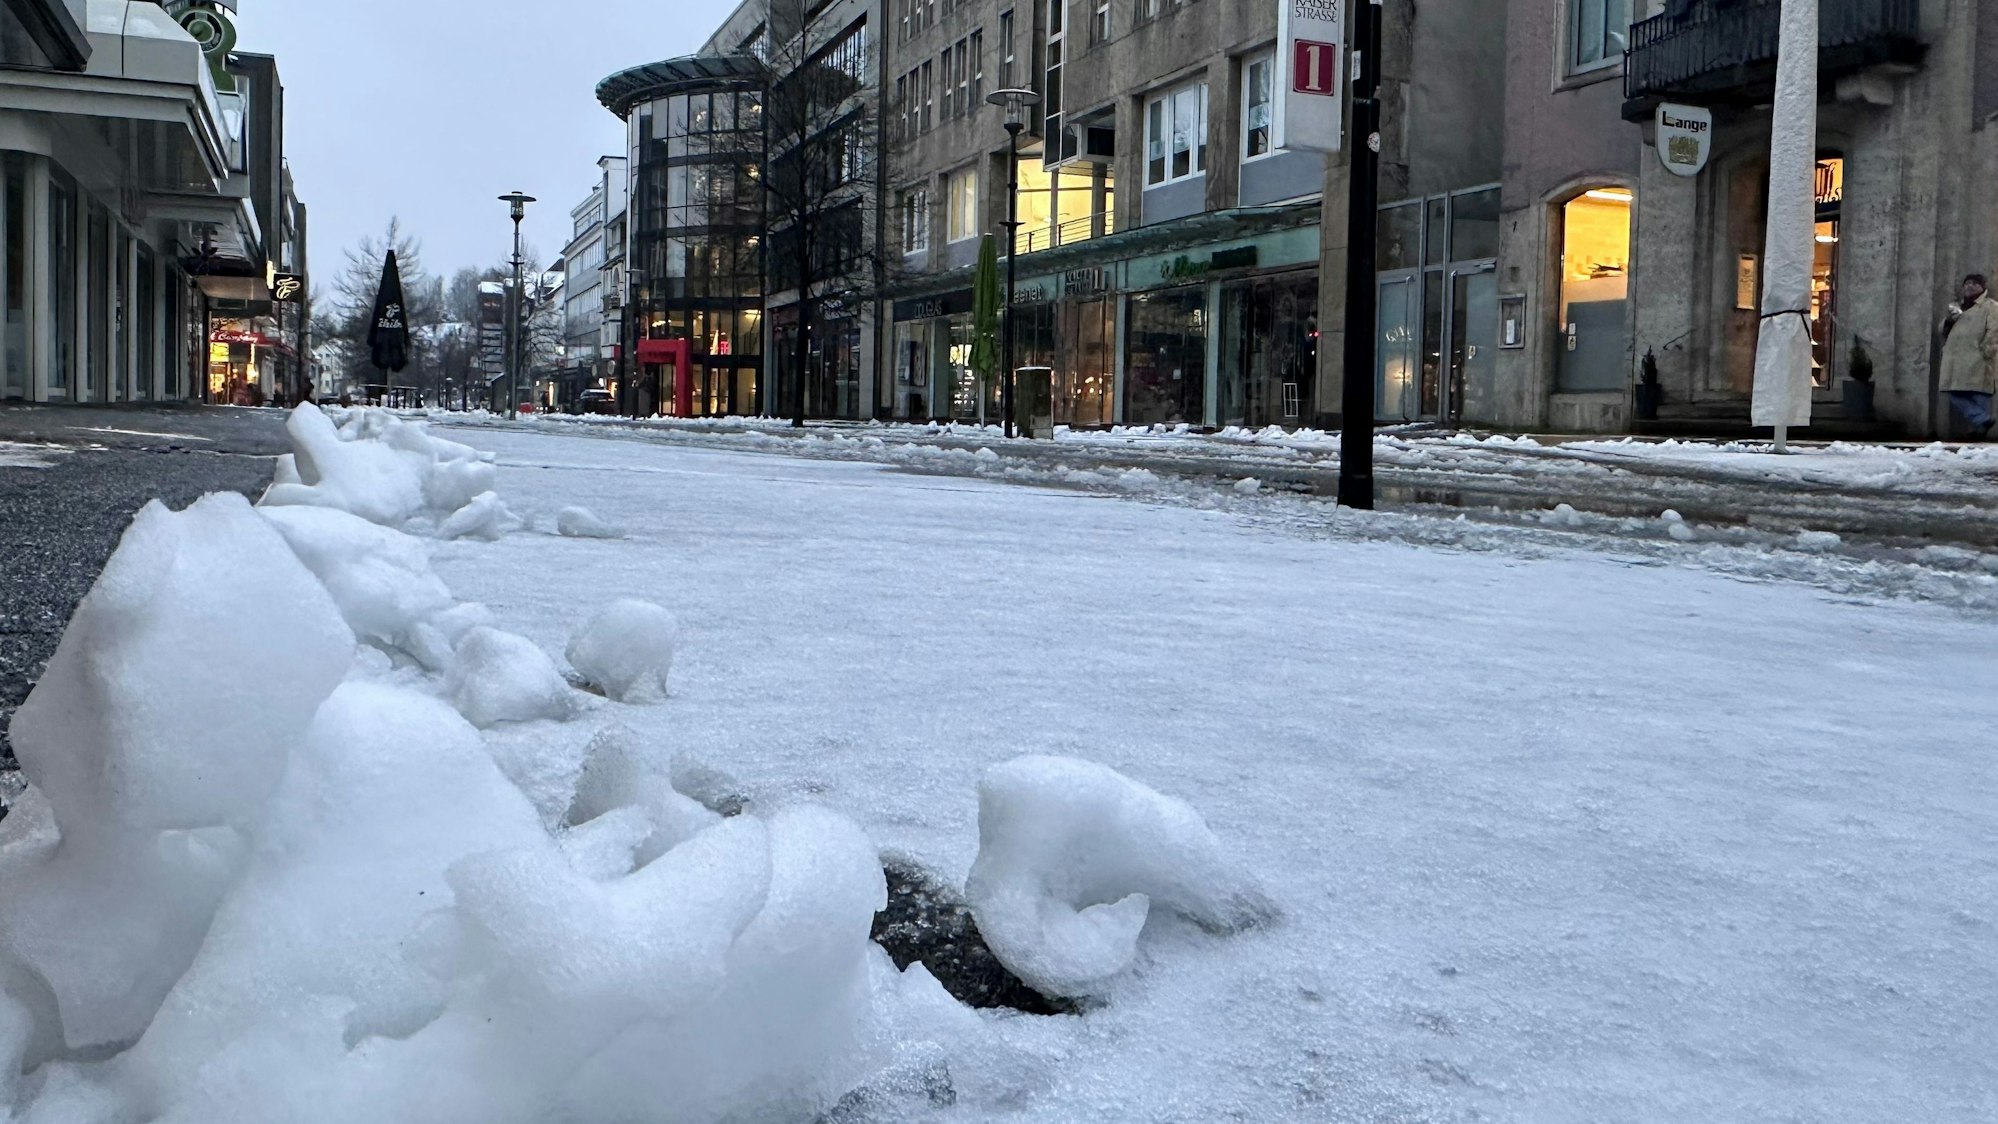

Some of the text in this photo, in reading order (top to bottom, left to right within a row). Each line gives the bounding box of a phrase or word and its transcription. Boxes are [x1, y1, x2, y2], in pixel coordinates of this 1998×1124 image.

[1296, 0, 1337, 10] KAISER
[1295, 7, 1337, 23] STRASSE
[1305, 45, 1322, 91] 1
[1662, 110, 1708, 133] Lange
